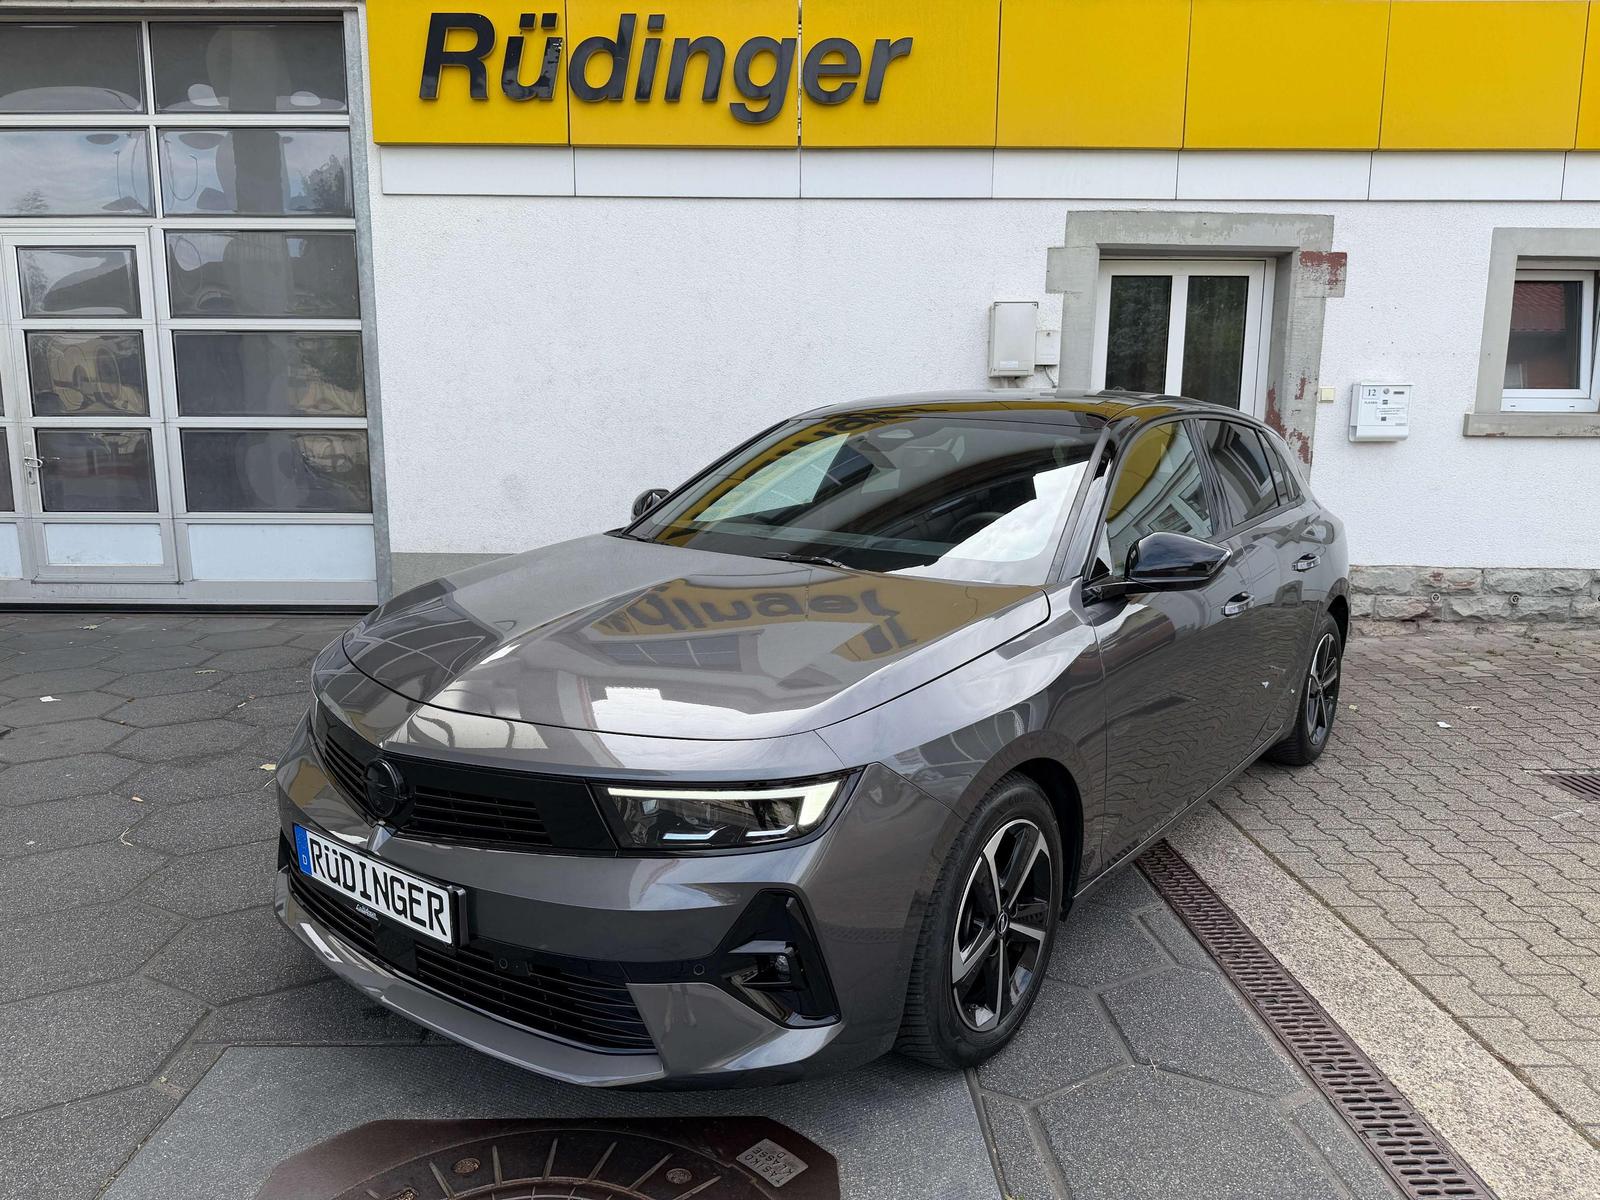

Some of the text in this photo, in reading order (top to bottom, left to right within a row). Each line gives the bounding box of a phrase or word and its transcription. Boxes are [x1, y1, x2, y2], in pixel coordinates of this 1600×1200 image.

[419, 12, 913, 124] Rüdinger
[1367, 388, 1377, 396] 12
[302, 837, 448, 937] D RÜDINGER
[753, 1148, 793, 1176] KLASSE
